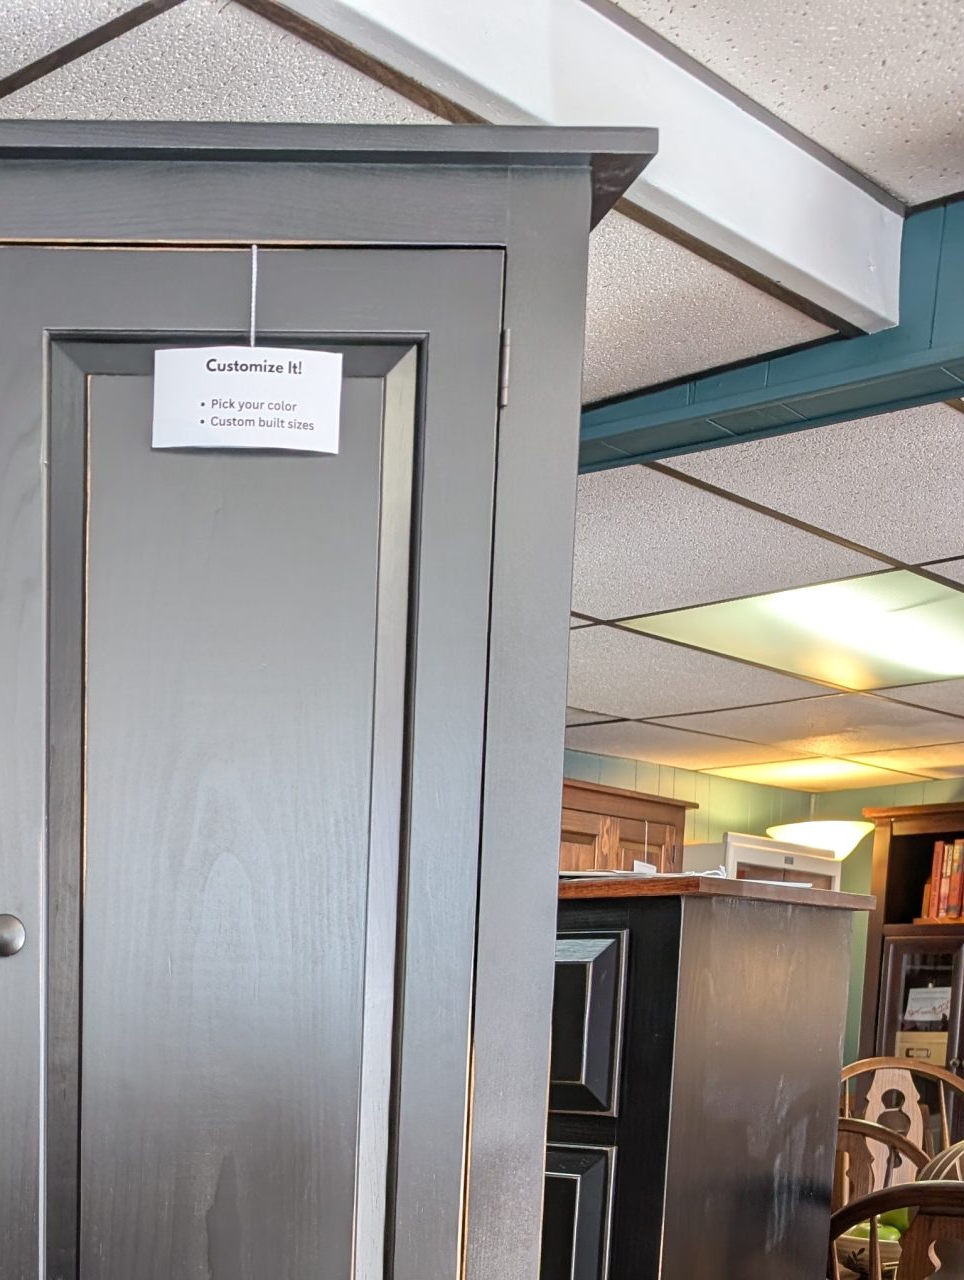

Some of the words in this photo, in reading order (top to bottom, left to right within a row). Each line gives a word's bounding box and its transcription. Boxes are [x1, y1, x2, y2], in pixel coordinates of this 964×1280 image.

[206, 358, 284, 374] Customize
[288, 361, 302, 375] It!
[211, 398, 235, 409] Pick
[238, 401, 265, 412] your
[267, 400, 297, 412] color
[210, 416, 255, 427] Custom
[258, 417, 285, 429] built
[287, 419, 314, 431] sizes
